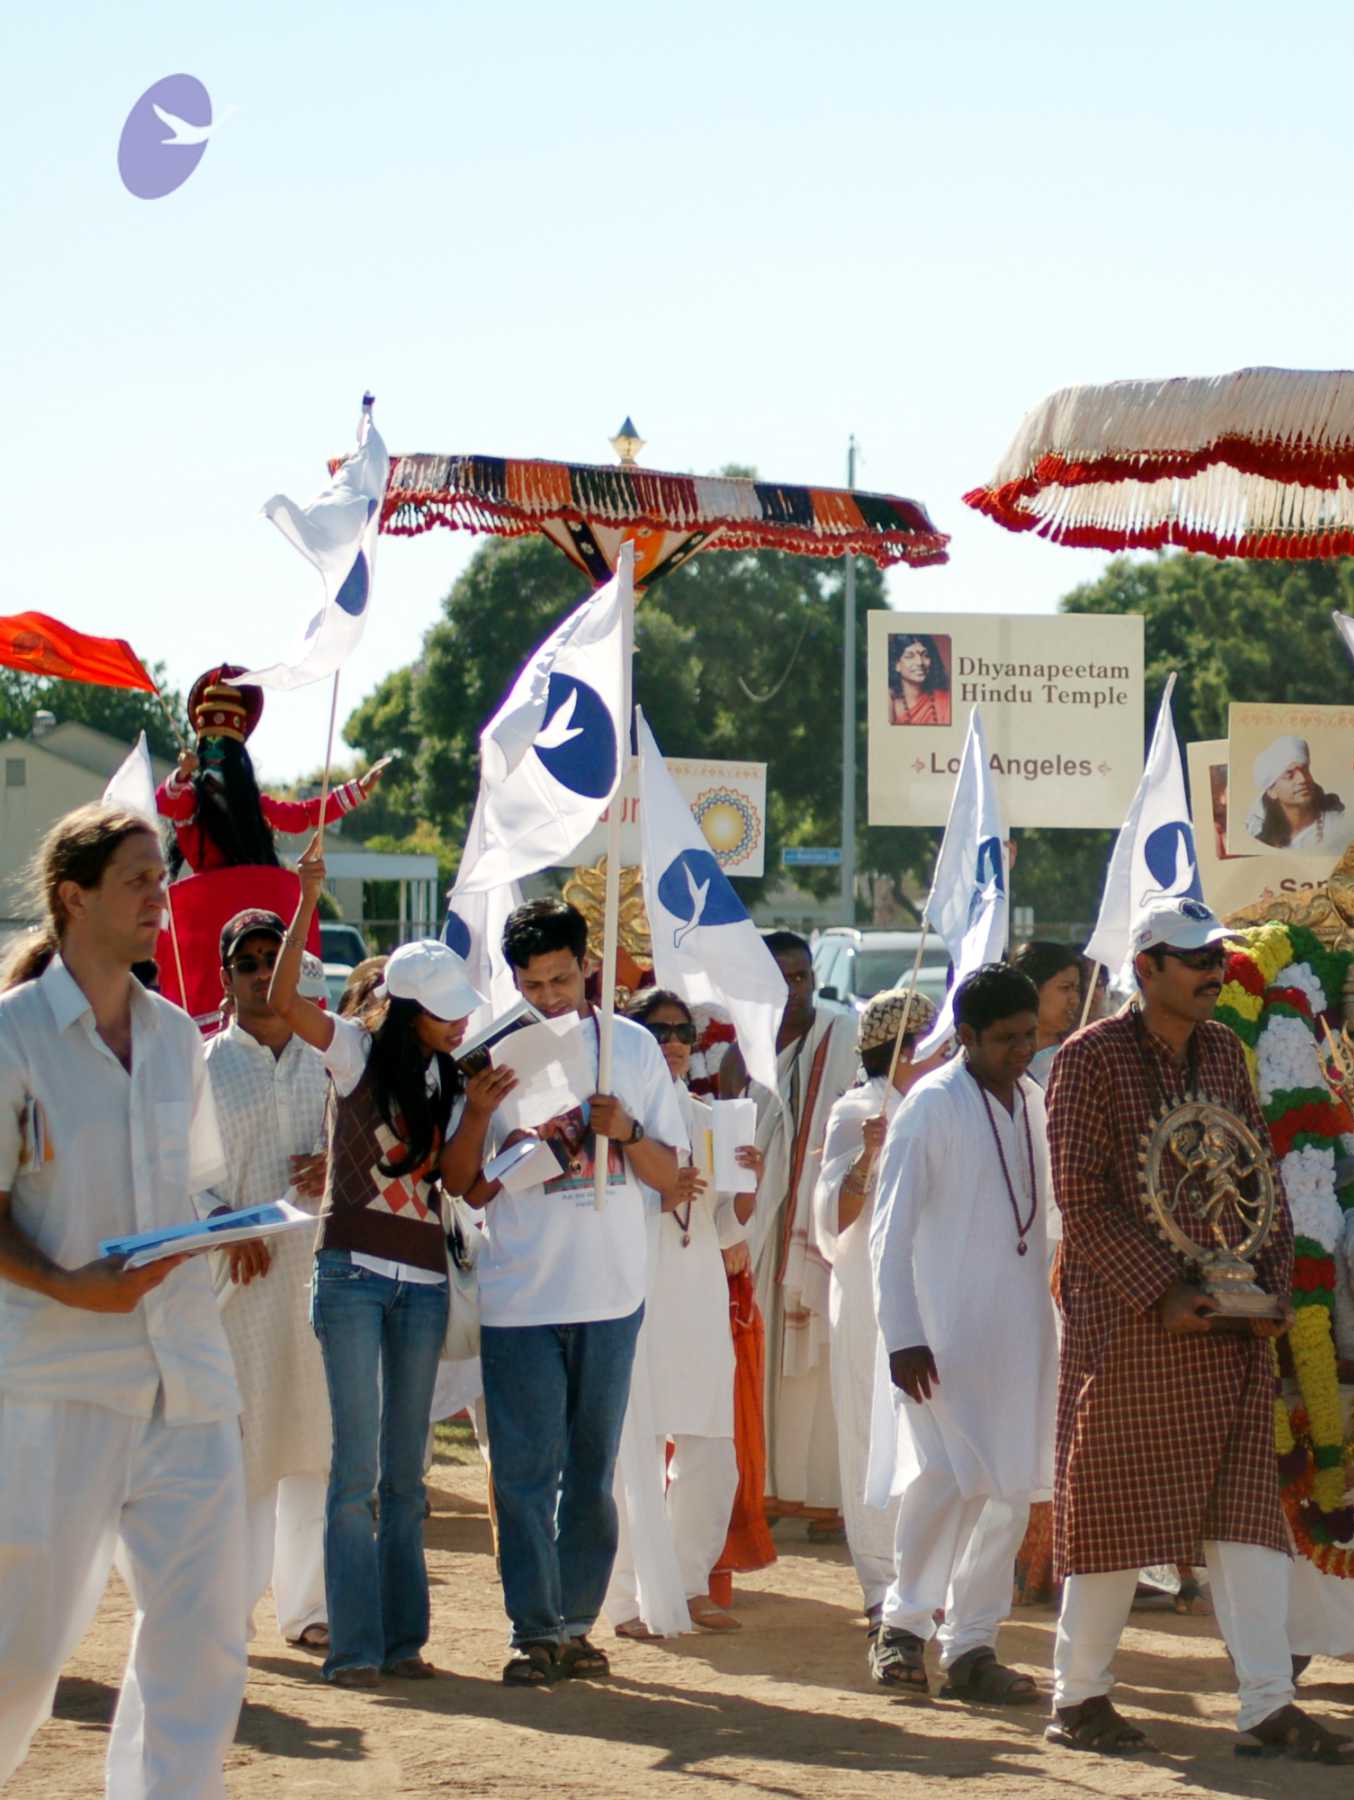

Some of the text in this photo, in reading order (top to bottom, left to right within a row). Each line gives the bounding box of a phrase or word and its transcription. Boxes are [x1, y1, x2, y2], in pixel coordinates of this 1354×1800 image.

[958, 656, 1131, 682] Dhyanapeetam
[961, 683, 1129, 709] Hindu Temple
[930, 752, 1093, 781] Lo Angeles
